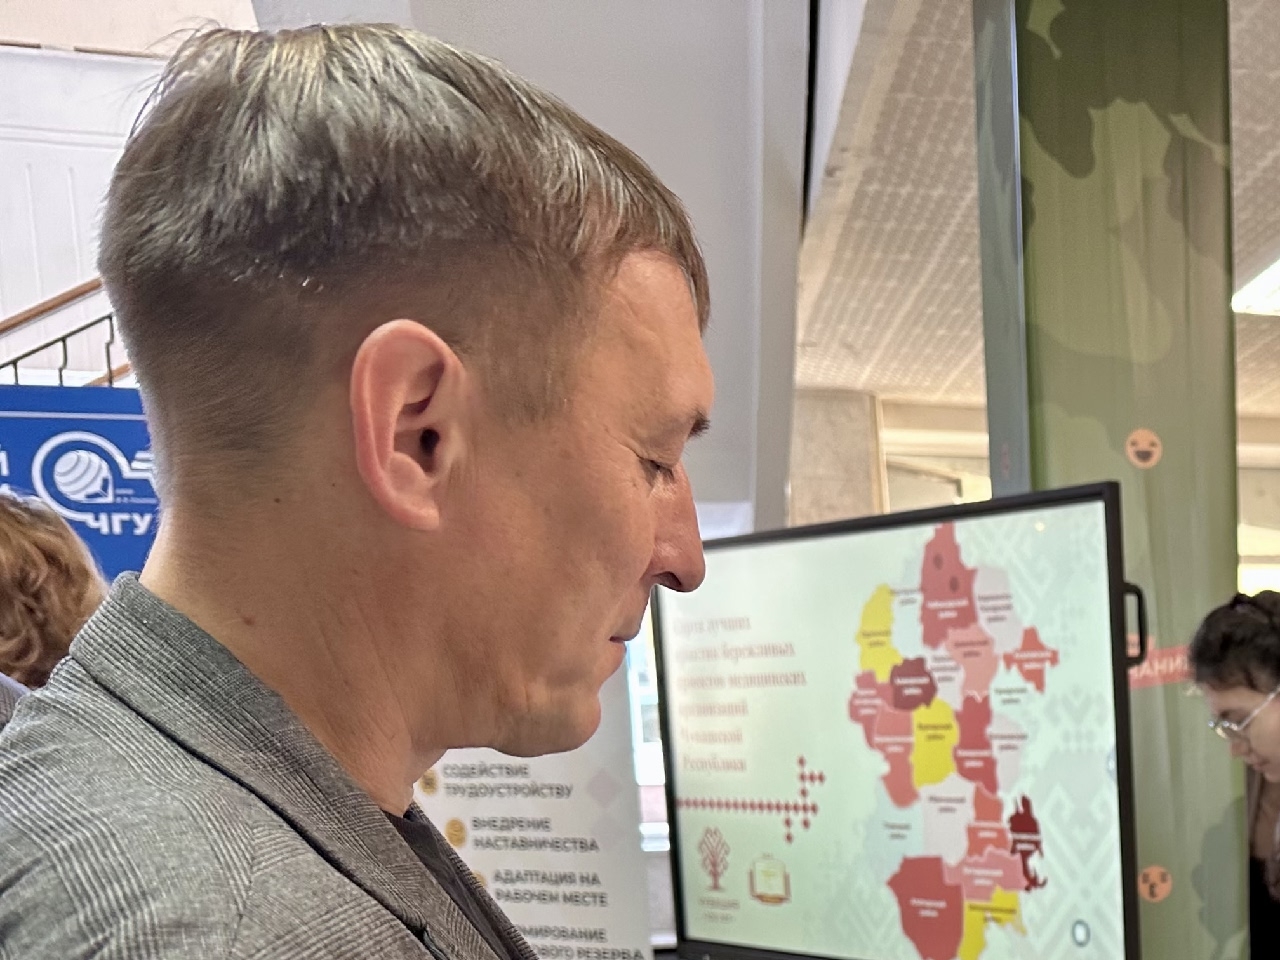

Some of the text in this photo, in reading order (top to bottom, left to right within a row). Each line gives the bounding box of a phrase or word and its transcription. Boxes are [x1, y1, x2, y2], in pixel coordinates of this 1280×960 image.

[443, 762, 529, 778] СОДЕЙСТВИЕ
[444, 780, 573, 798] ТРУДОУСТРОЙСТВУ
[472, 817, 552, 831] ВНЕДРЕНИЕ
[473, 837, 600, 852] НАСТАВНИЧЕСТВА
[493, 870, 601, 886] АДАПТАЦИЯ НА
[495, 890, 607, 907] РАБОЧЕМ МЕСТЕ
